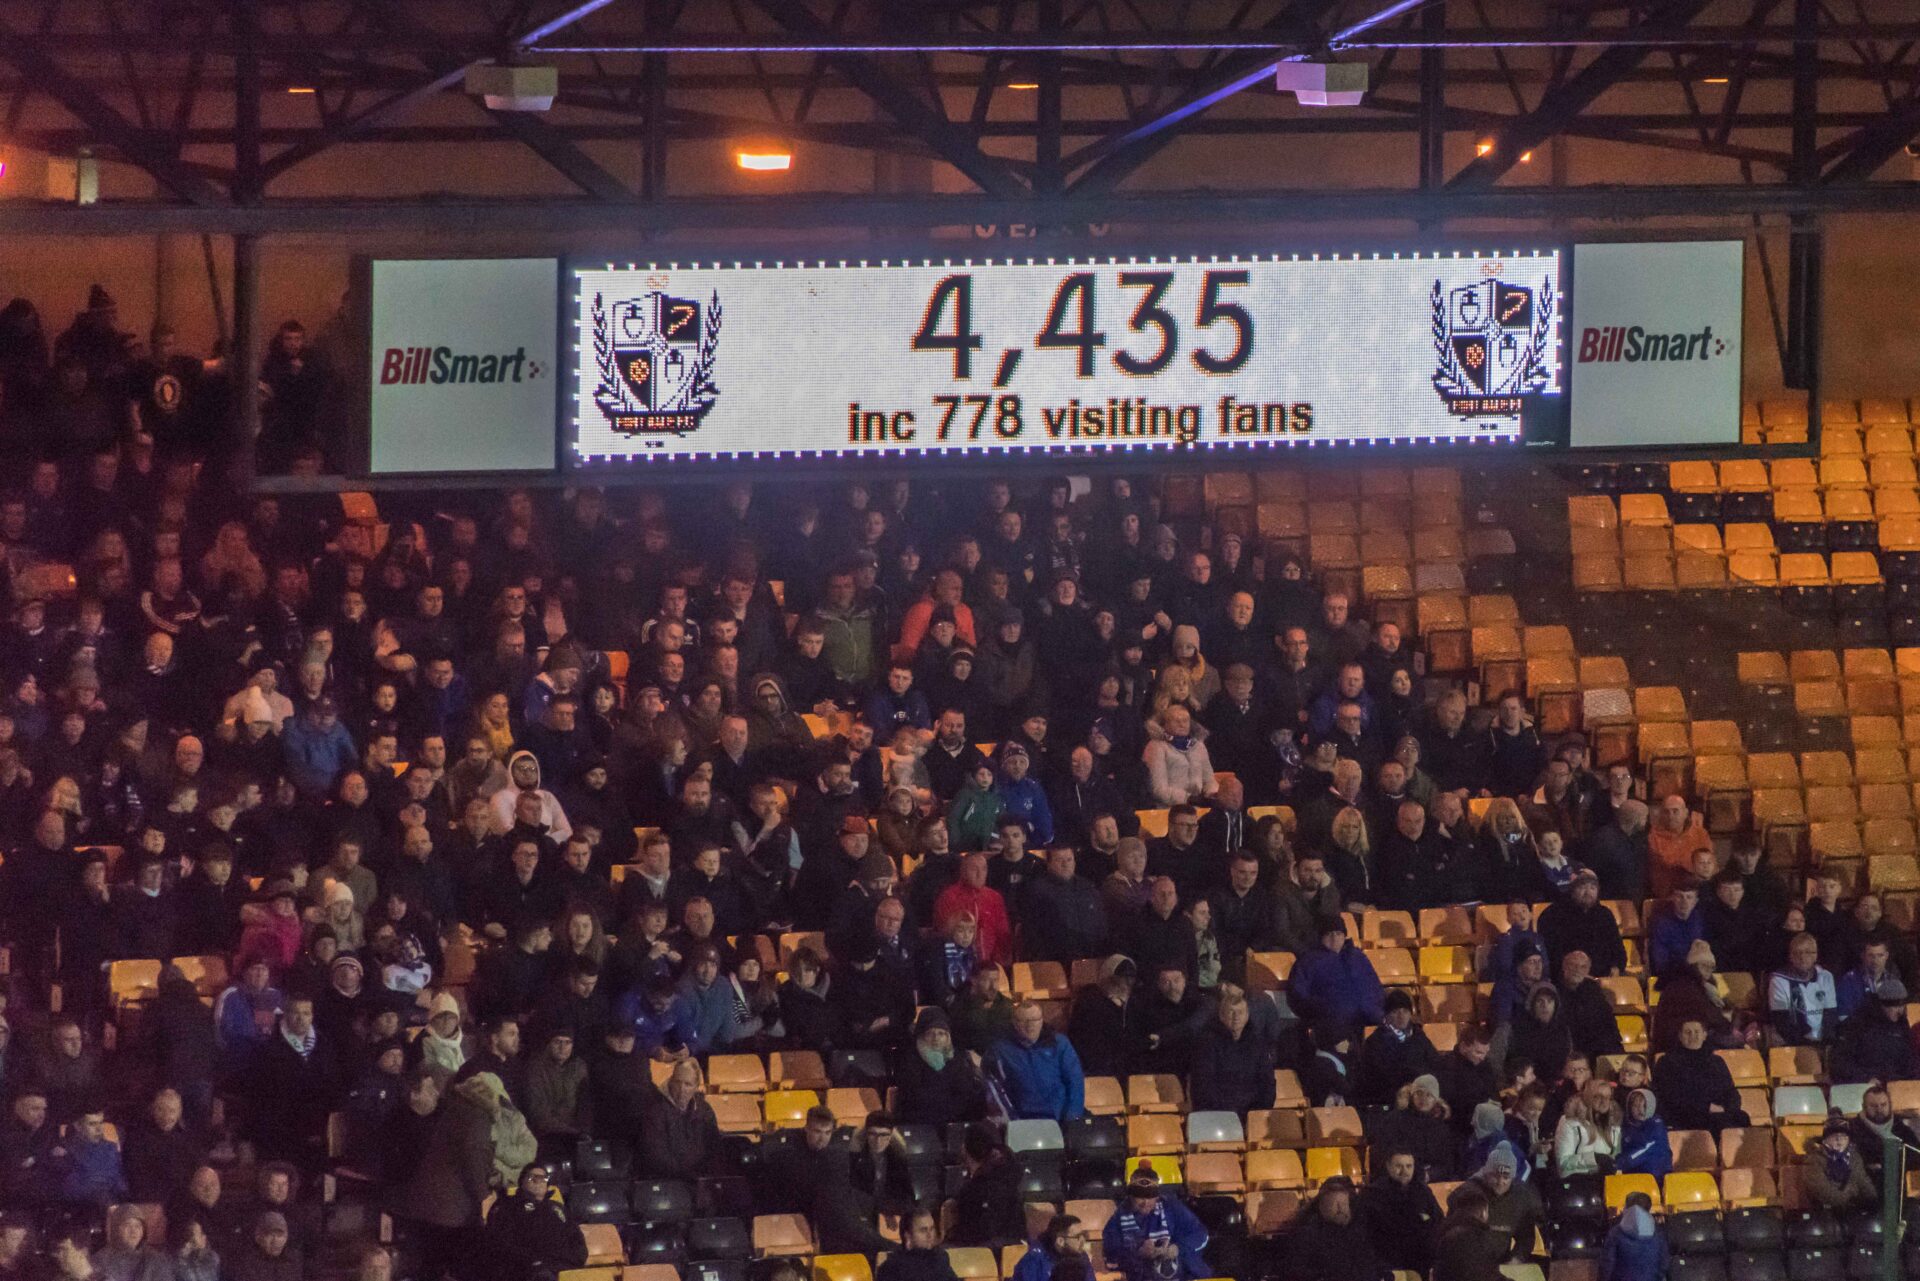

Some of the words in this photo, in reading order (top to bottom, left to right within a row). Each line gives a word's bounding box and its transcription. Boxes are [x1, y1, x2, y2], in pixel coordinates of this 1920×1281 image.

[911, 269, 1256, 389] 4,435
[1578, 325, 1712, 363] BillSmart
[379, 346, 526, 385] BillSmart
[847, 401, 916, 443] inc
[931, 395, 1024, 442] 778
[1040, 396, 1202, 443] visiting
[1217, 396, 1315, 436] fans
